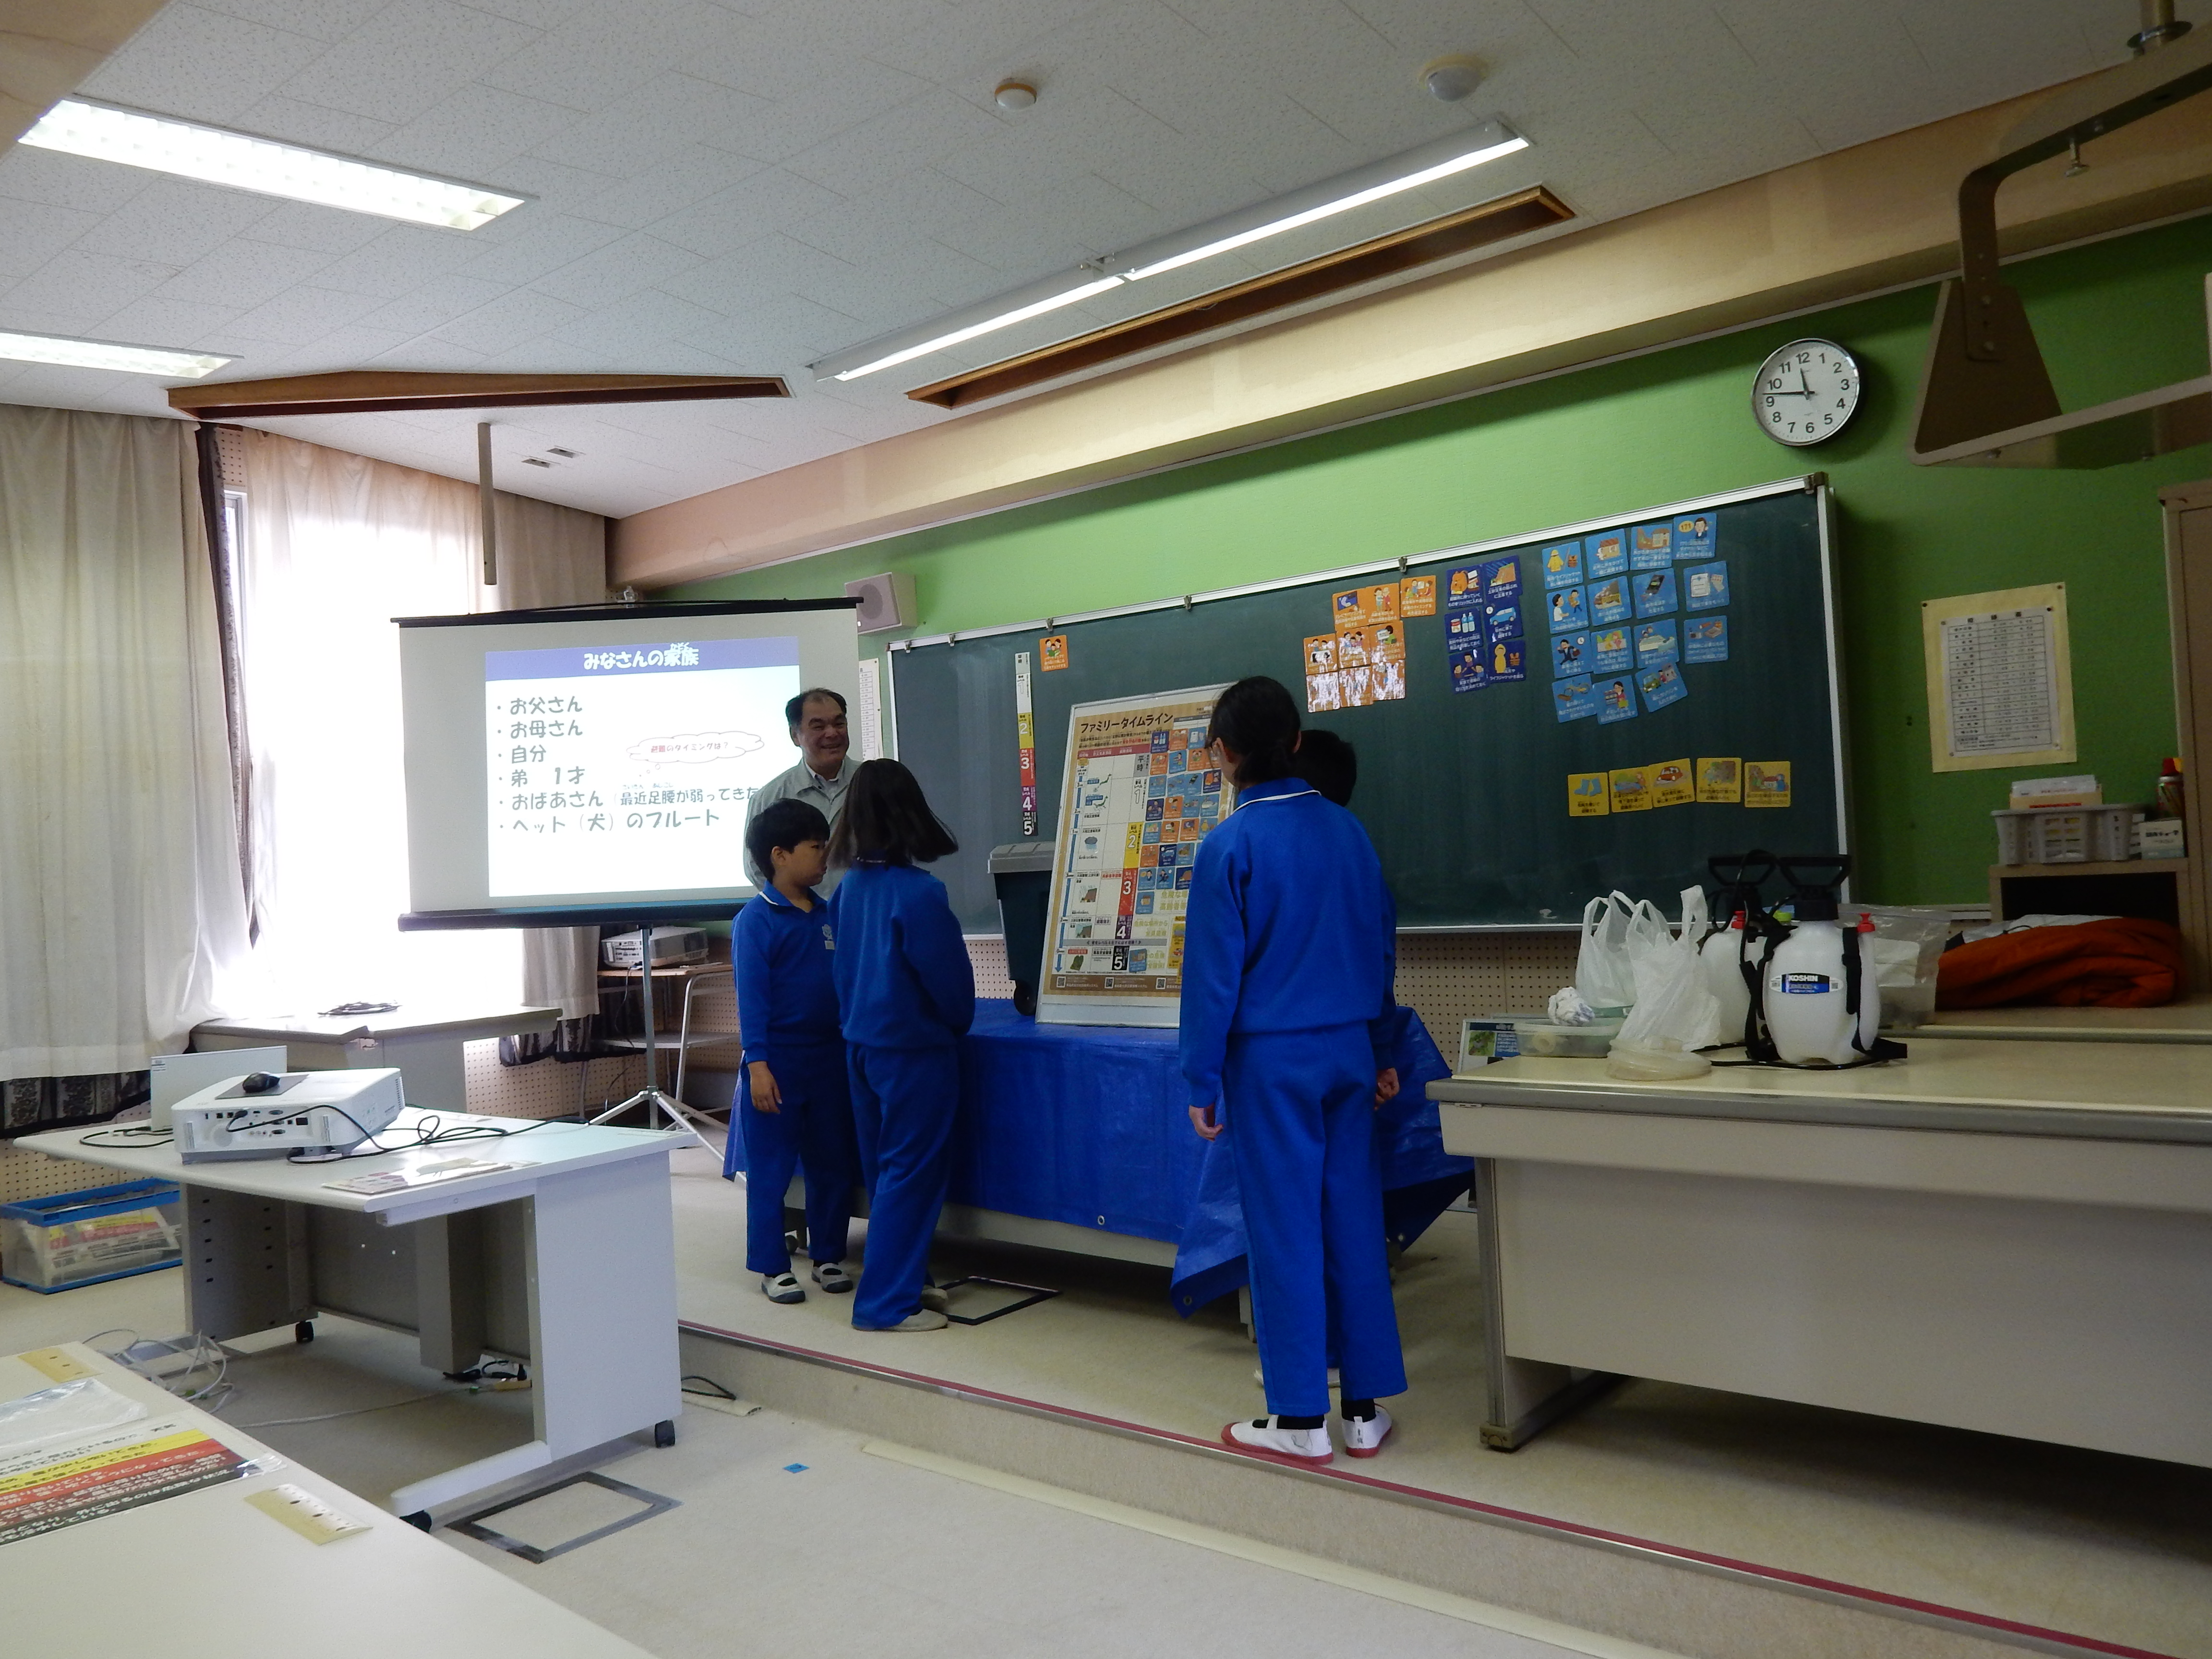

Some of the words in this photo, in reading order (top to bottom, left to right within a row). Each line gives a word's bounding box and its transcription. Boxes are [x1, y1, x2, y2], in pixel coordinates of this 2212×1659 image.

[1795, 352, 1810, 364] 12
[1819, 353, 1825, 363] 1
[1779, 361, 1791, 373] 11
[1833, 362, 1841, 373] 2
[1767, 378, 1782, 390] 10
[1841, 379, 1850, 390] 3
[1766, 396, 1775, 407] 9
[1837, 398, 1845, 409] 4
[1772, 411, 1781, 422] 8
[1824, 413, 1833, 424] 5
[1788, 421, 1796, 433] 7
[1805, 422, 1815, 433] 6
[584, 647, 699, 670] みなさんの家族
[1018, 682, 1024, 694] 1
[510, 696, 583, 715] お父さん
[1019, 722, 1028, 735] 2
[1081, 713, 1174, 733] ファミリータイムライン
[510, 720, 583, 739] お母さん
[512, 745, 546, 764] 自分
[1021, 757, 1030, 769] 3
[511, 769, 528, 787] 弟
[1134, 789, 1141, 804] 1
[1022, 796, 1032, 811] 4
[1024, 821, 1032, 835] 5
[1128, 834, 1137, 849] 2
[1123, 880, 1131, 895] 3
[1117, 926, 1126, 939] 4
[1114, 956, 1123, 970] 5
